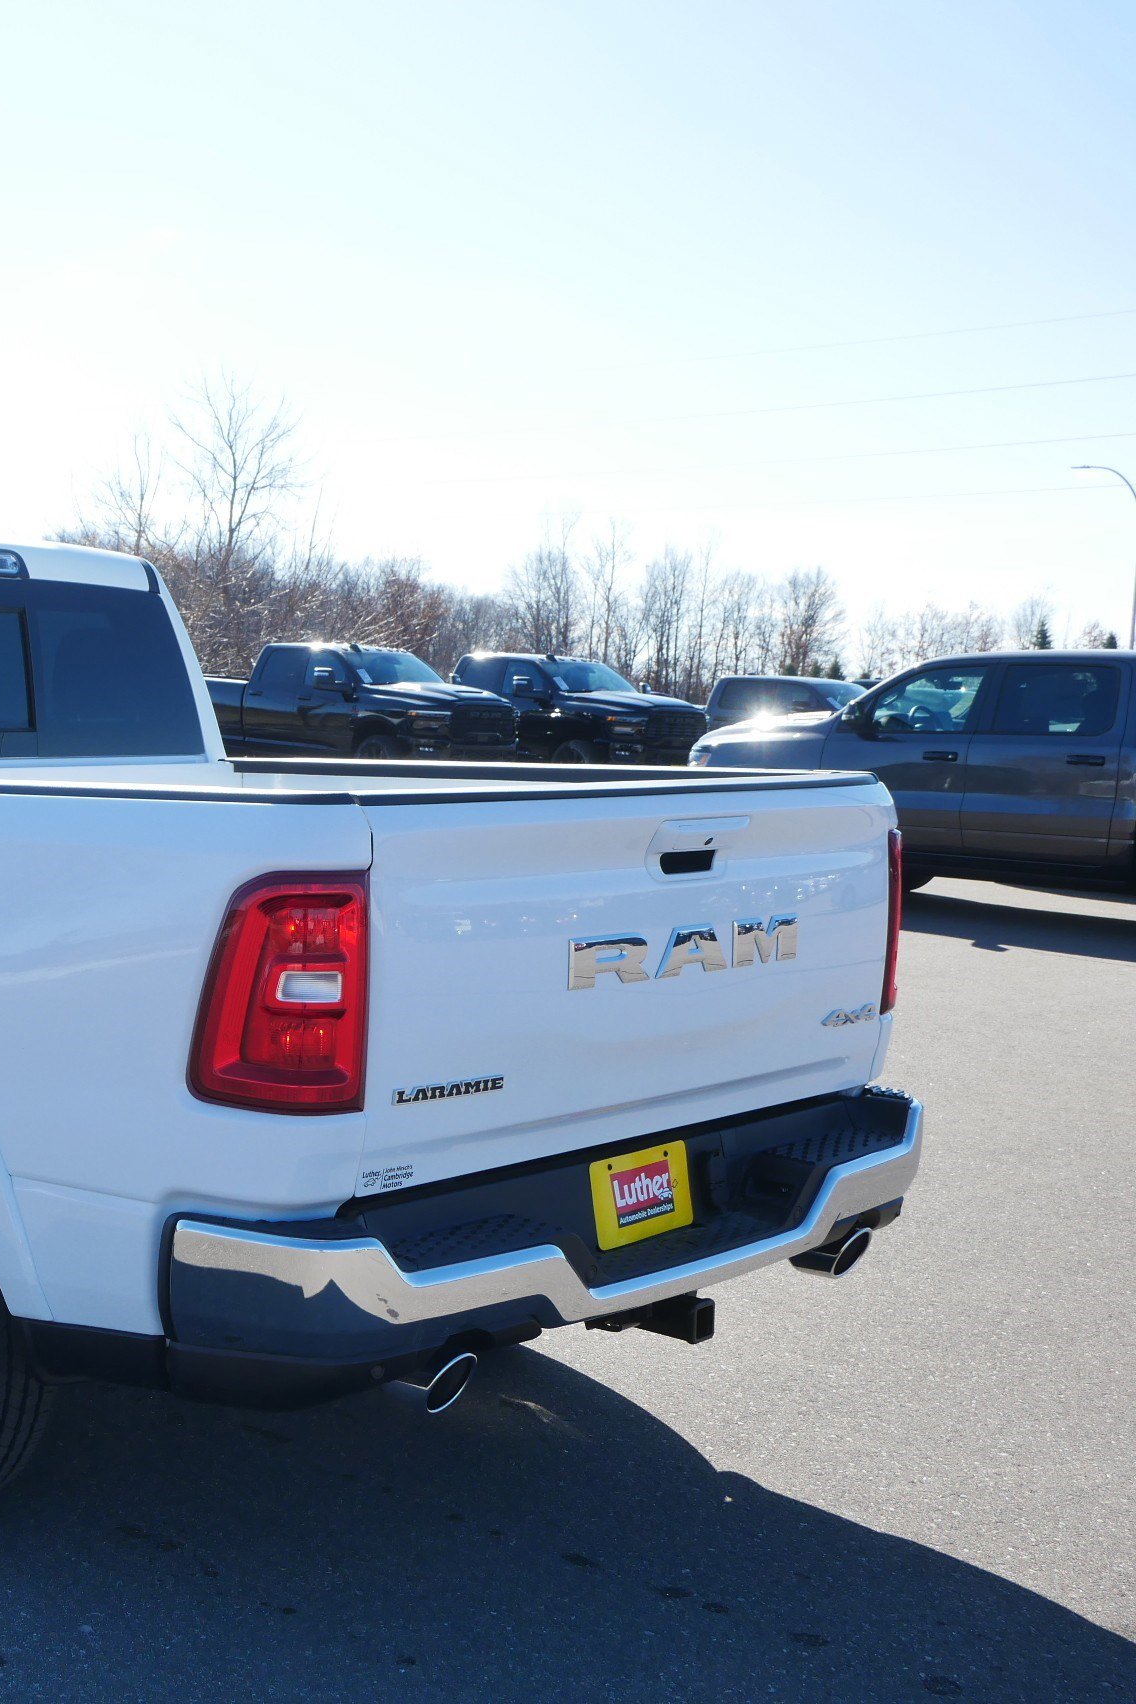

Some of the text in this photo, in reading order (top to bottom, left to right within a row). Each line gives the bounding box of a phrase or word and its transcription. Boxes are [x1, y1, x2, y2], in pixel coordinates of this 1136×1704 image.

[567, 912, 798, 990] RAM
[393, 1075, 504, 1105] LARAMIE
[382, 1180, 403, 1189] Motors
[384, 1171, 414, 1181] Cambridge
[612, 1172, 669, 1208] Luther
[619, 1202, 674, 1224] Automobile Dealerships
